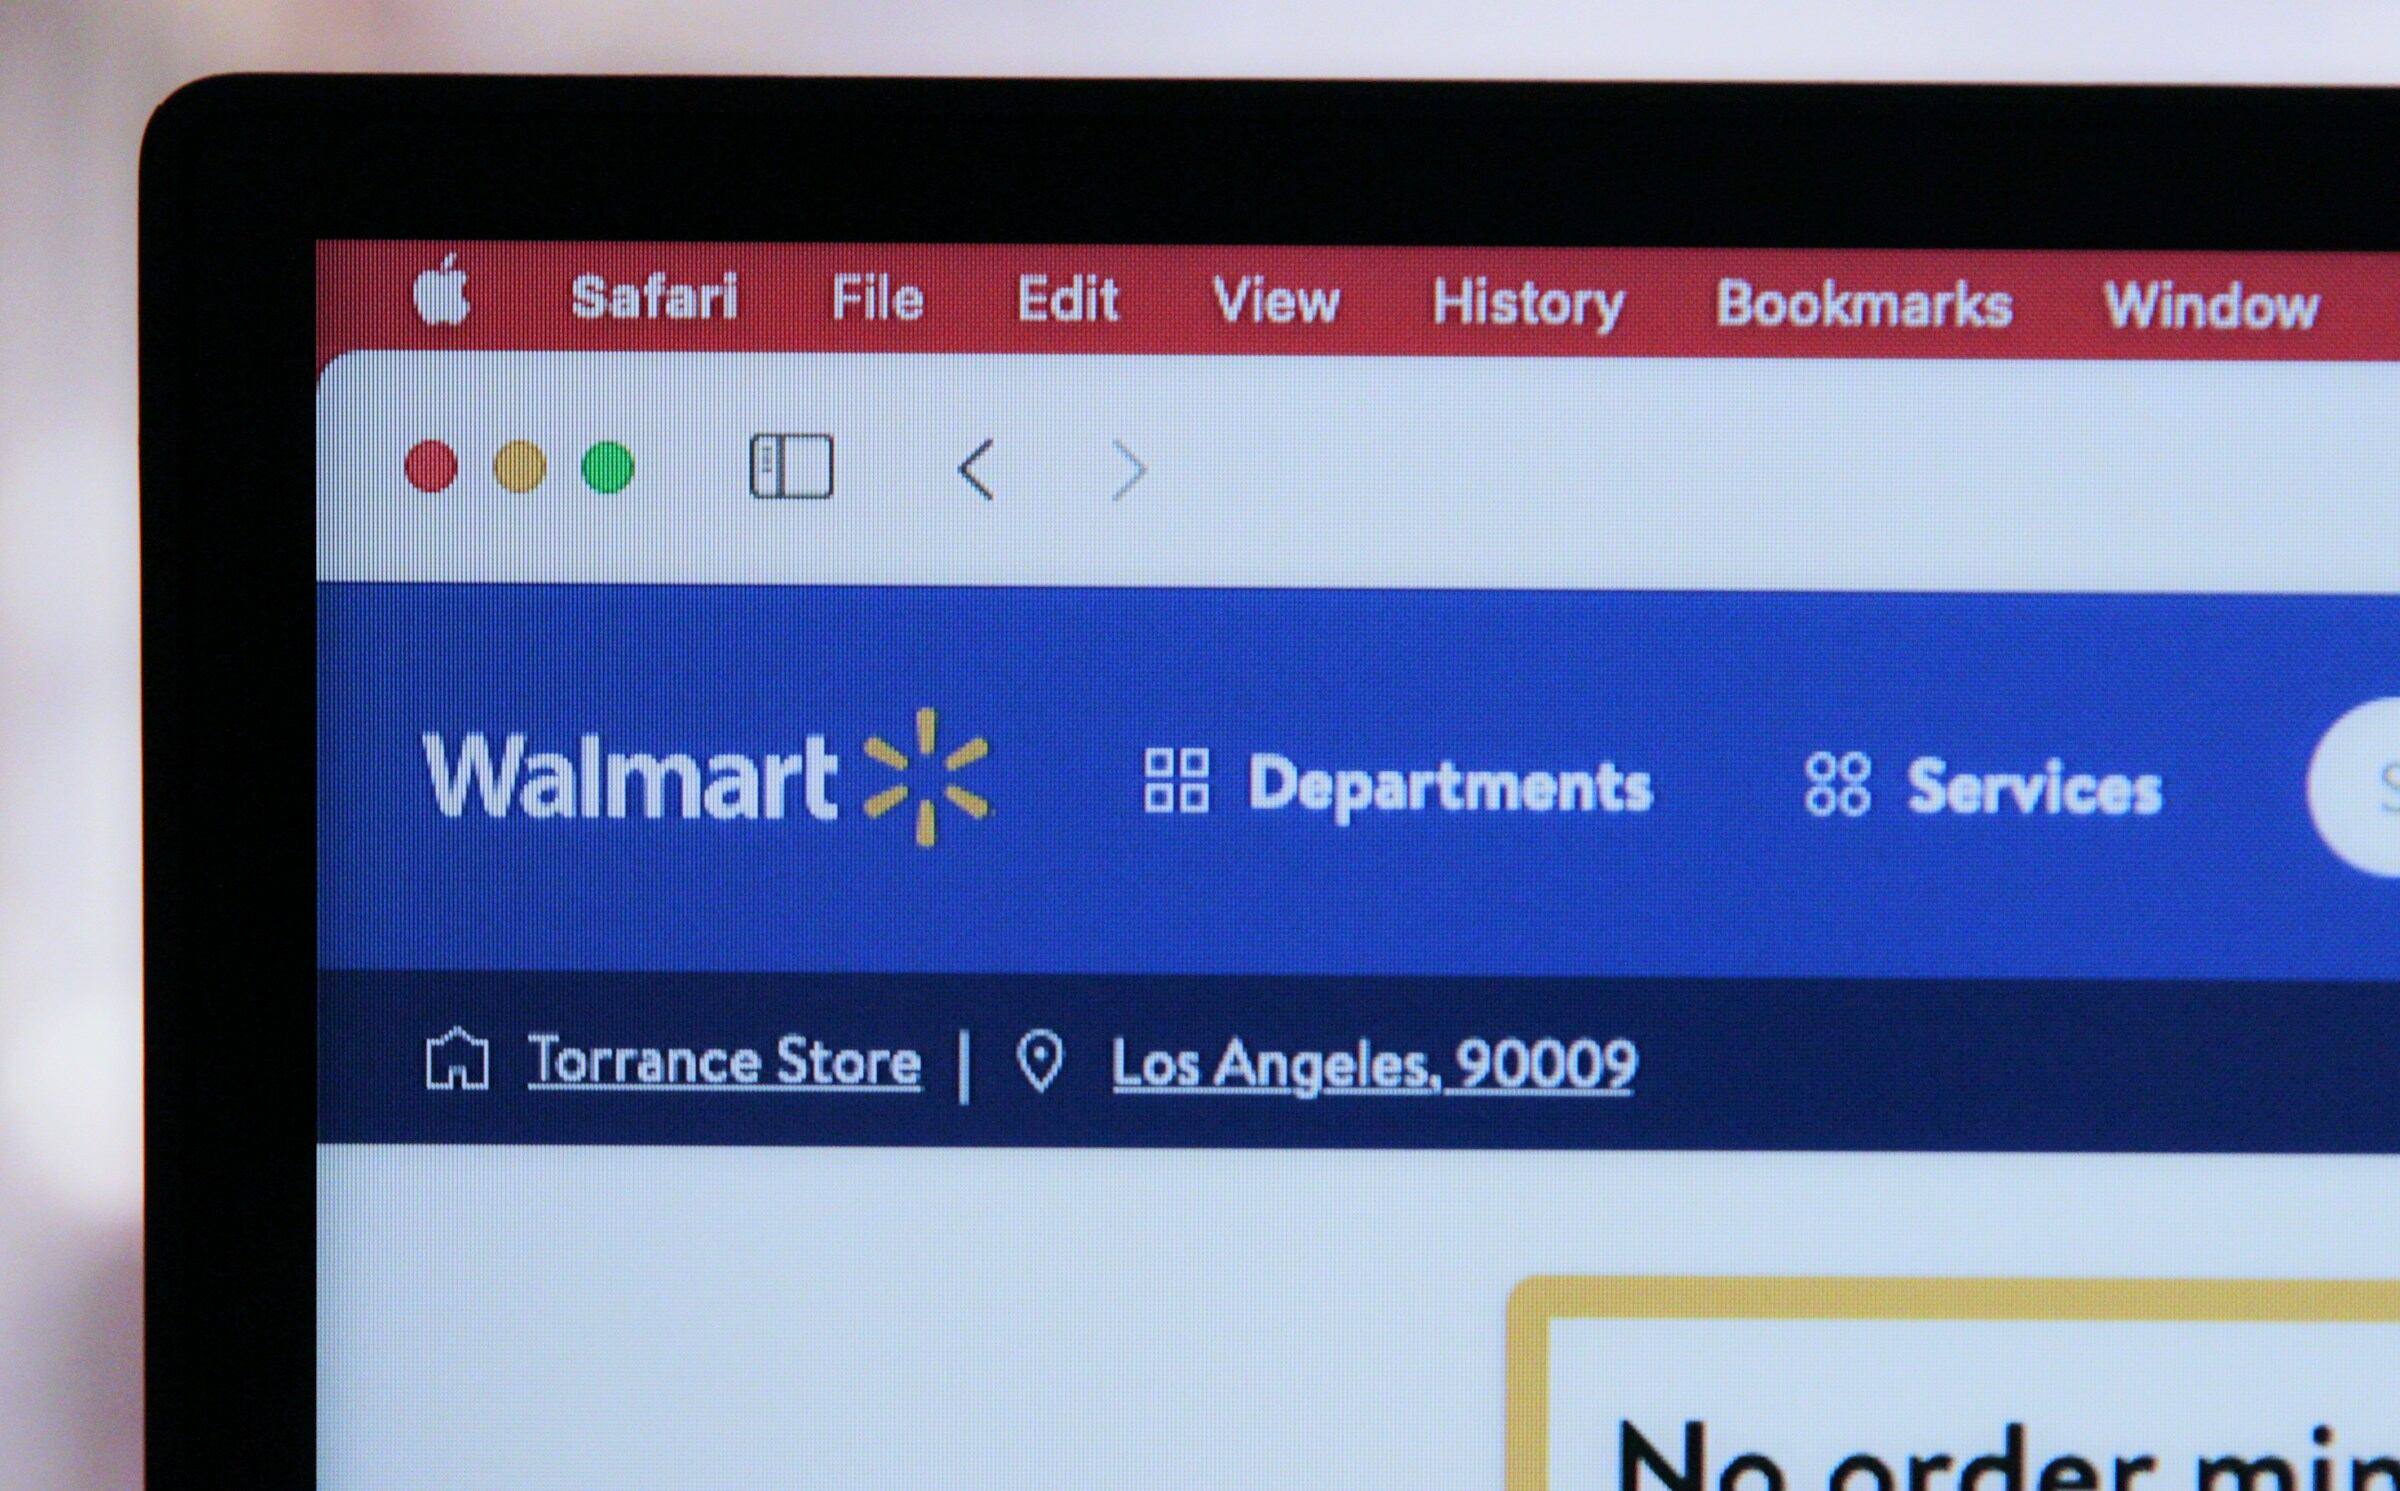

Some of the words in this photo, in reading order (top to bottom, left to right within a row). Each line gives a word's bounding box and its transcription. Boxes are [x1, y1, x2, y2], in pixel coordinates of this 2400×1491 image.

[571, 271, 738, 319] Safari
[832, 272, 925, 321] File
[1018, 273, 1120, 322] Edit
[1212, 274, 1342, 323] View
[1433, 276, 1626, 335] History
[1716, 277, 2014, 329] Bookmarks
[2104, 279, 2321, 330] Window
[422, 733, 838, 822] Walmart
[1249, 753, 1654, 827] Departments
[1907, 756, 2162, 815] Services
[527, 1033, 762, 1091] Torrance
[776, 1034, 922, 1092] Store
[1112, 1036, 1202, 1094] Los
[1454, 1037, 1638, 1096] 90009
[1619, 1419, 1787, 1491] No
[1828, 1421, 2157, 1491] order
